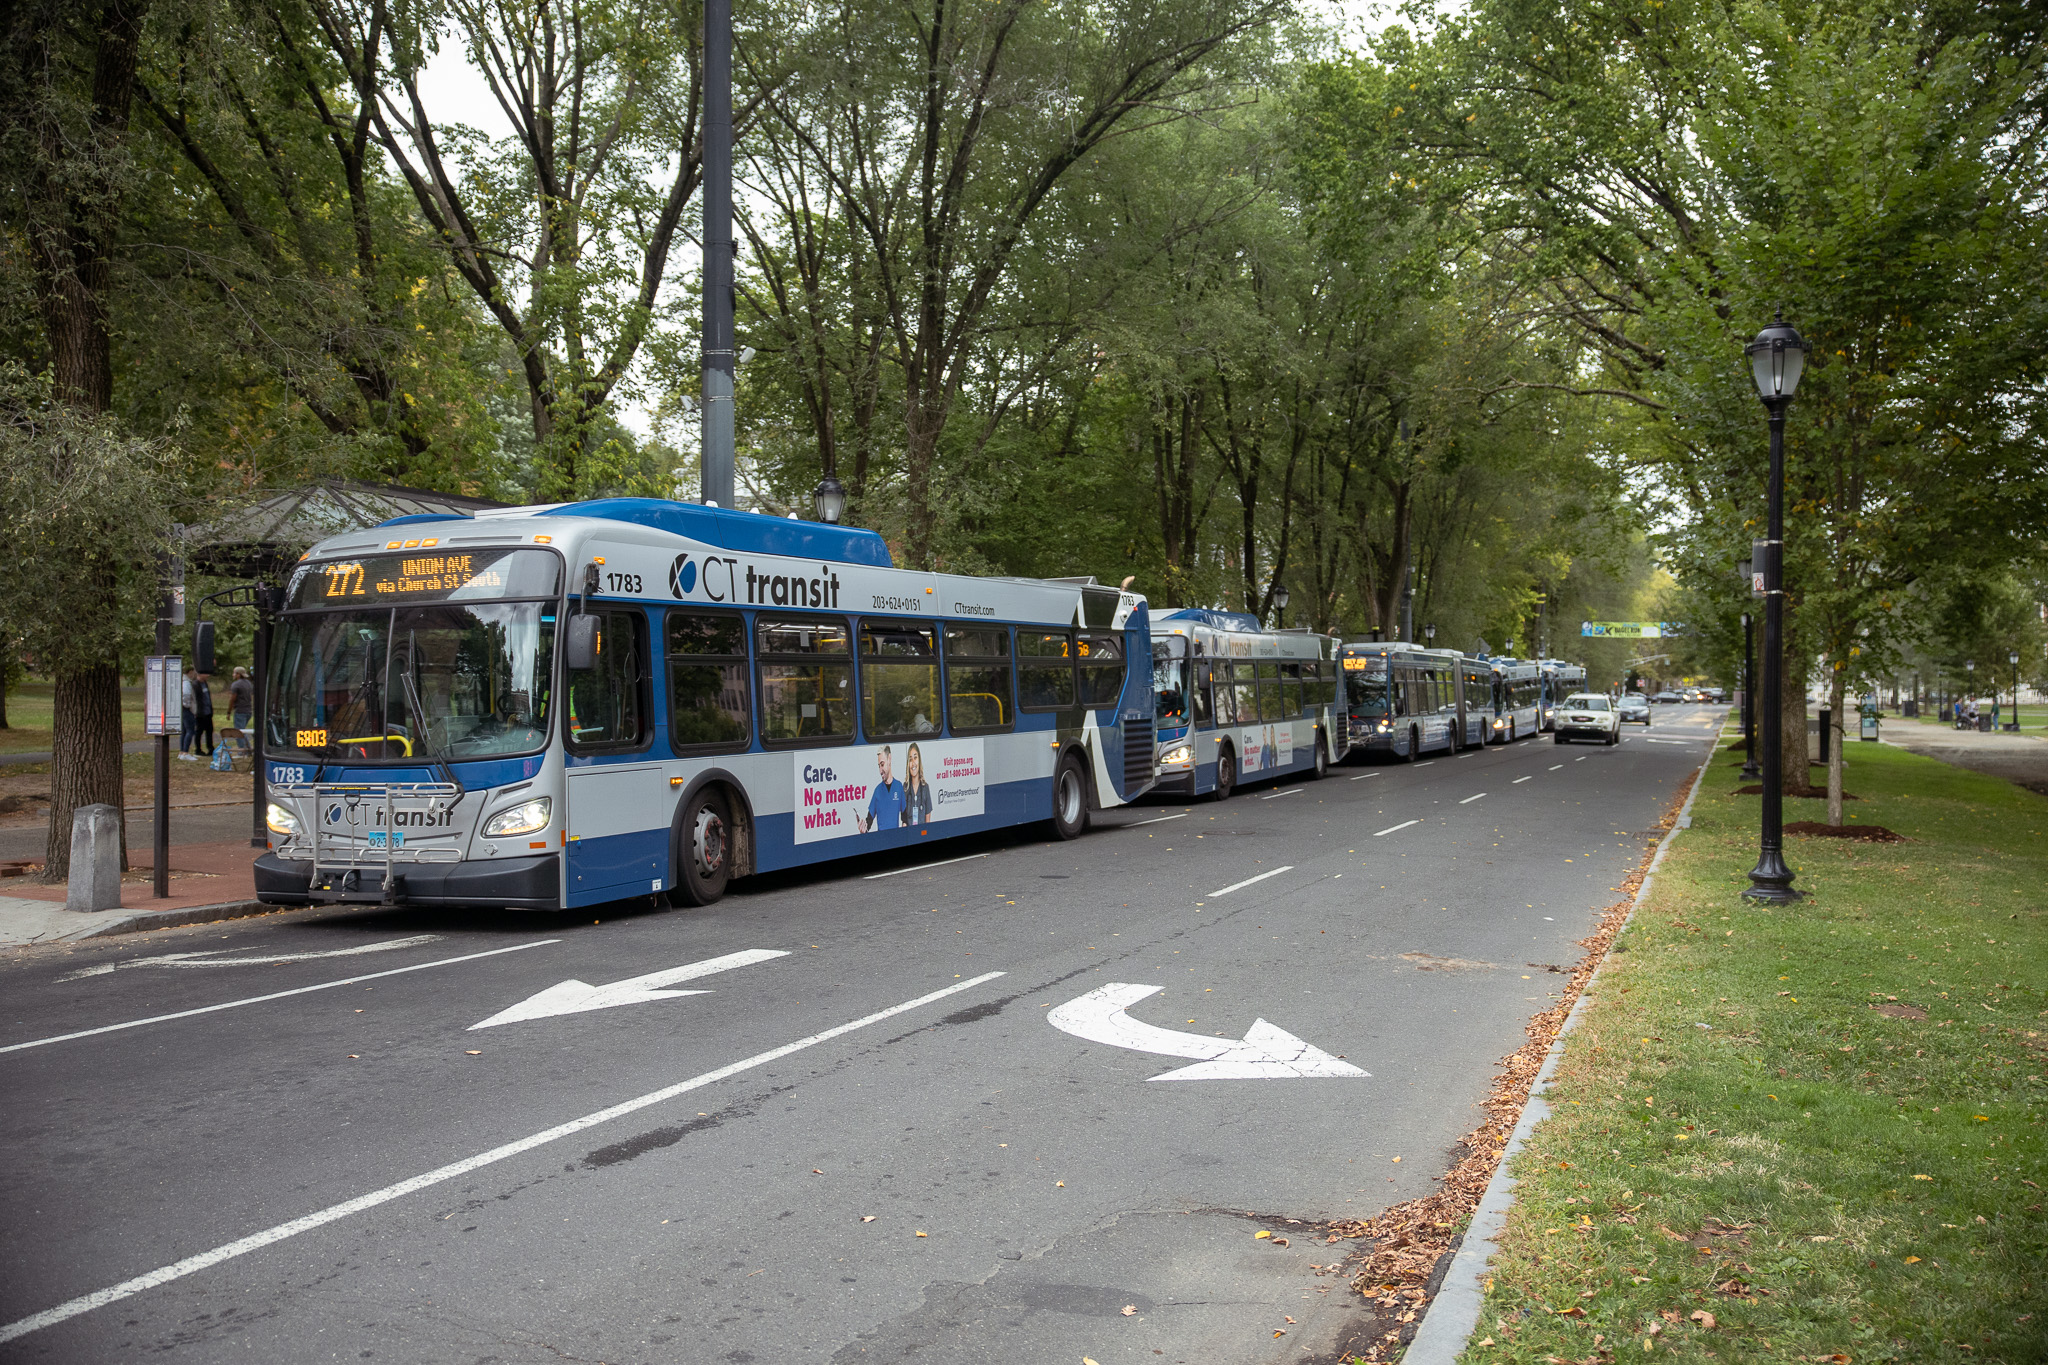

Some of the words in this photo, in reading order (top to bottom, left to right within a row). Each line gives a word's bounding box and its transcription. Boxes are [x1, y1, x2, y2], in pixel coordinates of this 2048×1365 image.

[402, 557, 445, 576] UNION
[446, 555, 473, 574] AVE
[326, 563, 366, 597] 272
[376, 578, 396, 593] via
[397, 575, 442, 592] Church
[443, 573, 461, 589] St
[462, 571, 501, 588] South
[606, 572, 643, 594] 1783
[702, 555, 738, 603] CT
[746, 564, 840, 609] transit
[954, 602, 995, 616] CTtransit.com
[1121, 594, 1135, 607] 1783
[296, 729, 327, 748] 6803
[943, 757, 953, 766] Visit
[272, 766, 304, 783] 1783
[803, 764, 837, 784] Care.
[941, 770, 949, 779] call
[949, 767, 981, 778] 1-800-230-PLAN
[804, 787, 822, 807] No
[825, 784, 867, 804] matter
[345, 803, 371, 826] CT
[803, 807, 841, 830] what.
